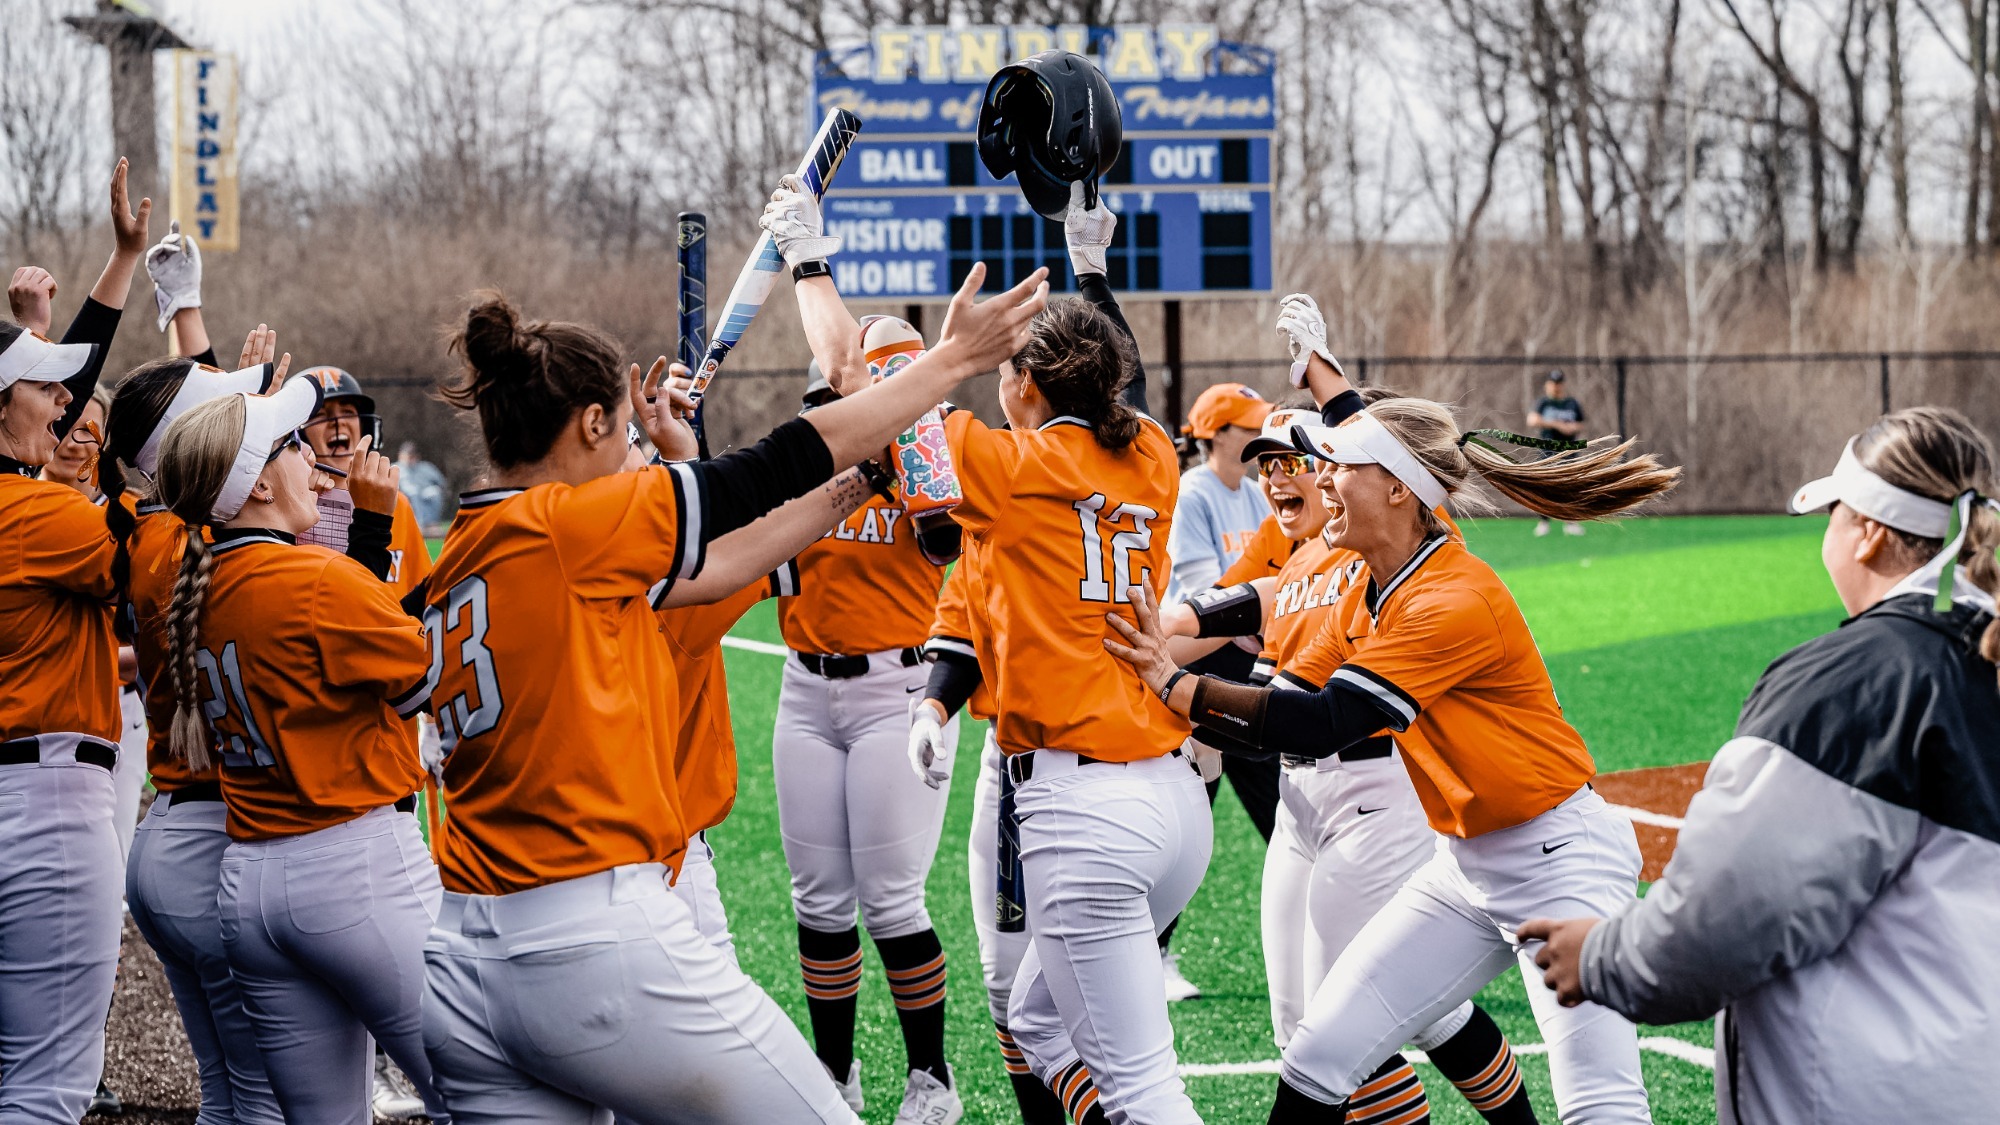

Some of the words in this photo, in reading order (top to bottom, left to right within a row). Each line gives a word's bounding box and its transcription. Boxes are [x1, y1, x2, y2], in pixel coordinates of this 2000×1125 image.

[1124, 86, 1270, 126] Trojans
[196, 60, 220, 239] FINDLAY
[860, 149, 945, 182] BALL
[1150, 145, 1218, 179] OUT
[1197, 191, 1255, 212] TOTAL
[826, 218, 946, 253] VISITOR
[836, 259, 938, 294] HOME
[824, 507, 902, 545] LAY
[1072, 491, 1159, 605] 12
[423, 573, 505, 758] 23
[196, 640, 278, 768] 21
